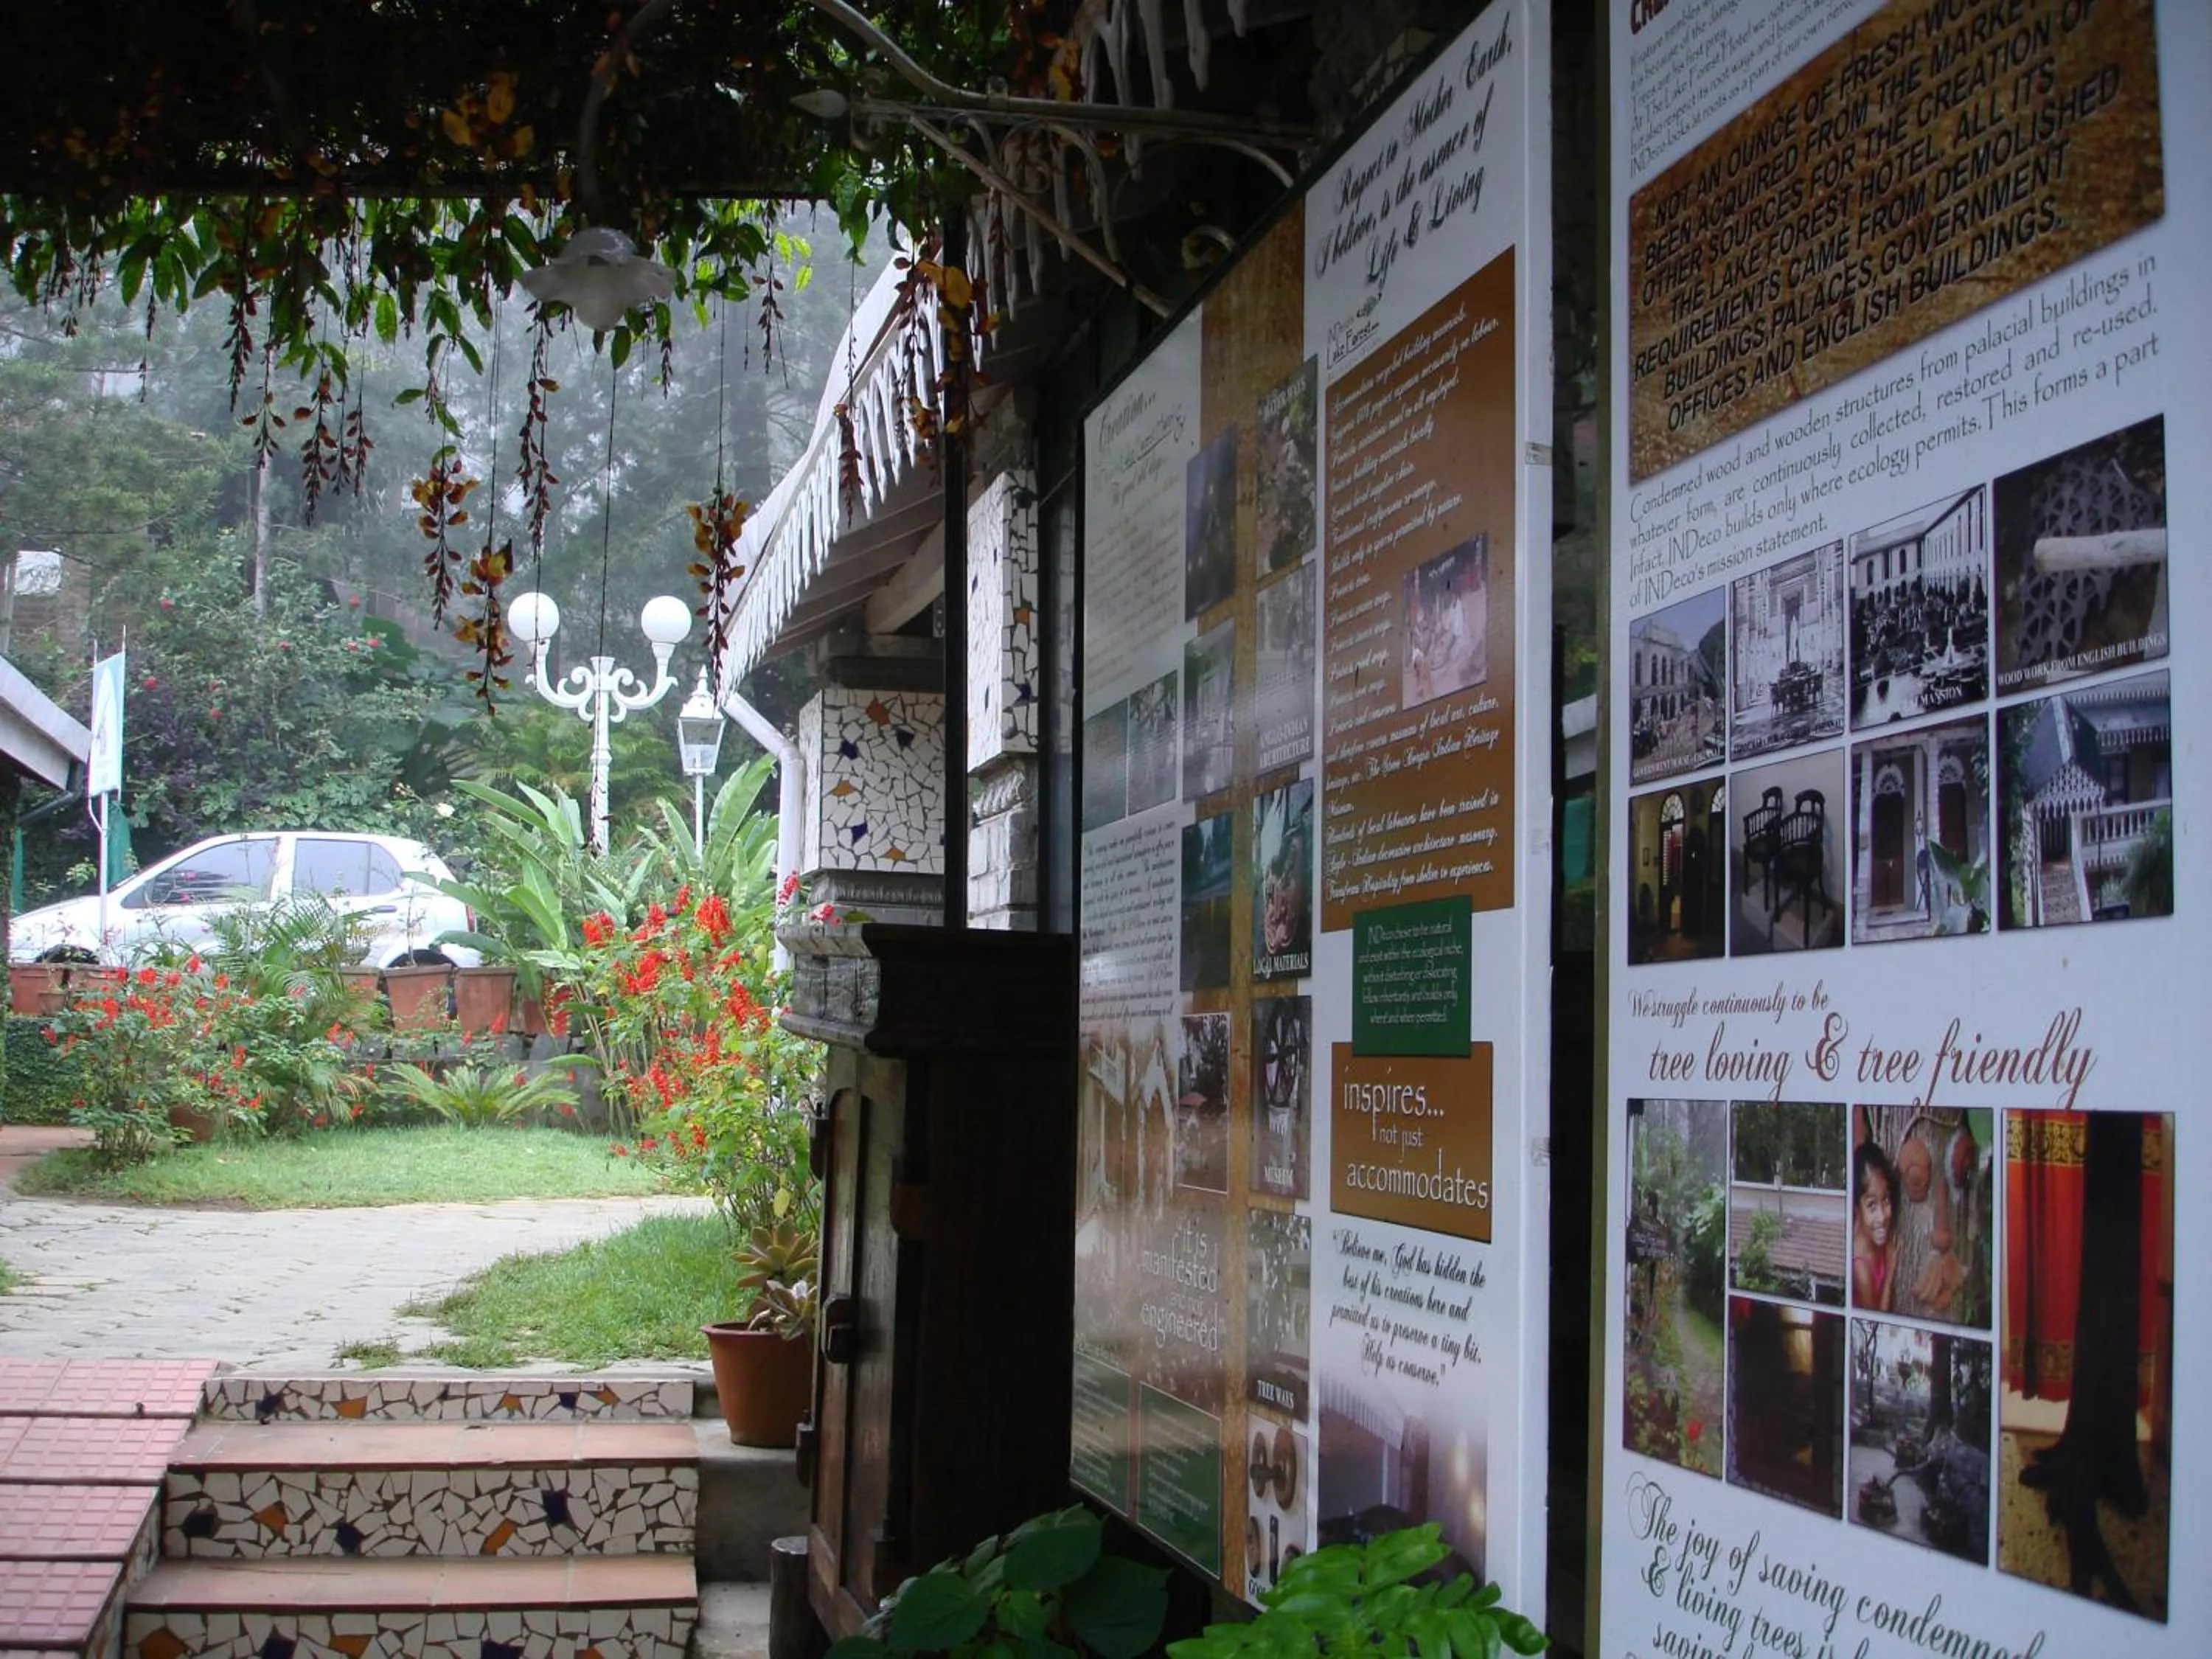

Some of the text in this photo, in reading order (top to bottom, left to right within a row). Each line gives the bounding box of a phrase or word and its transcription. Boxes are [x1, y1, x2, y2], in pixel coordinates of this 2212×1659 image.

[1642, 248, 1702, 307] OTHER
[1708, 178, 1802, 263] SOURCES
[1810, 142, 1855, 196] FOR
[1865, 110, 1910, 163] THE
[1917, 14, 2053, 128] CREATION
[1644, 220, 1692, 271] BEEN
[1698, 145, 1798, 229] ACQUIRED
[1805, 89, 1869, 164] FROM
[1878, 58, 1921, 113] THE
[1655, 187, 1694, 228] NOT
[1697, 164, 1721, 197] AN
[1727, 102, 1798, 178] OUNCE
[1804, 77, 1834, 123] OF
[1840, 16, 1917, 101] FRESH
[1427, 164, 1484, 234] Living
[1634, 62, 2121, 382] REQUIREMENTS CAME FROM DEMOLISHED
[1670, 284, 1704, 325] THE
[1709, 246, 1761, 298] LAKE
[1770, 190, 1851, 262] FOREST
[1955, 94, 2004, 145] ALL
[2013, 55, 2056, 113] ITS
[1882, 139, 2070, 276] GOVERNMENT
[1628, 511, 1680, 551] whatever
[1724, 484, 1745, 509] are
[1752, 431, 1842, 495] continuously
[1849, 389, 1927, 451] collected,
[1936, 347, 2012, 411] restored
[2024, 325, 2062, 371] and
[2072, 282, 2157, 349] re-used.
[1630, 253, 2157, 524] Condemned wood and wooden structures from palacial buildings in
[1668, 374, 1746, 433] OFFICES
[1750, 339, 1797, 386] AND
[1803, 280, 1902, 361] ENGLISH
[1724, 500, 1764, 538] builds
[1767, 484, 1798, 522] only
[1800, 467, 1845, 504] where
[1848, 442, 1910, 484] ecology
[1916, 413, 1981, 470] permits.
[1980, 388, 2029, 431] This
[2034, 366, 2088, 406] forms
[2094, 361, 2107, 380] a
[2114, 332, 2160, 387] part
[1628, 582, 1644, 608] of
[1706, 546, 1754, 577] mission
[1755, 512, 1829, 555] statement.
[1627, 978, 1829, 1029] We struggle continuously to be
[1649, 1005, 2100, 1110] tree loving & tree friendly
[1344, 1065, 1444, 1141] inspires...
[1380, 1123, 1425, 1164] not just
[1346, 1147, 1489, 1209] accommodates
[1434, 1251, 1467, 1283] hidden
[1470, 1259, 1486, 1289] the
[1448, 1295, 1473, 1321] and
[1625, 1470, 1680, 1546] The
[1675, 1518, 1723, 1581] joy
[1727, 1529, 1761, 1597] of
[1758, 1553, 1850, 1635] saving
[1641, 1545, 1809, 1659] & living trees
[1652, 1621, 1728, 1659] savi
